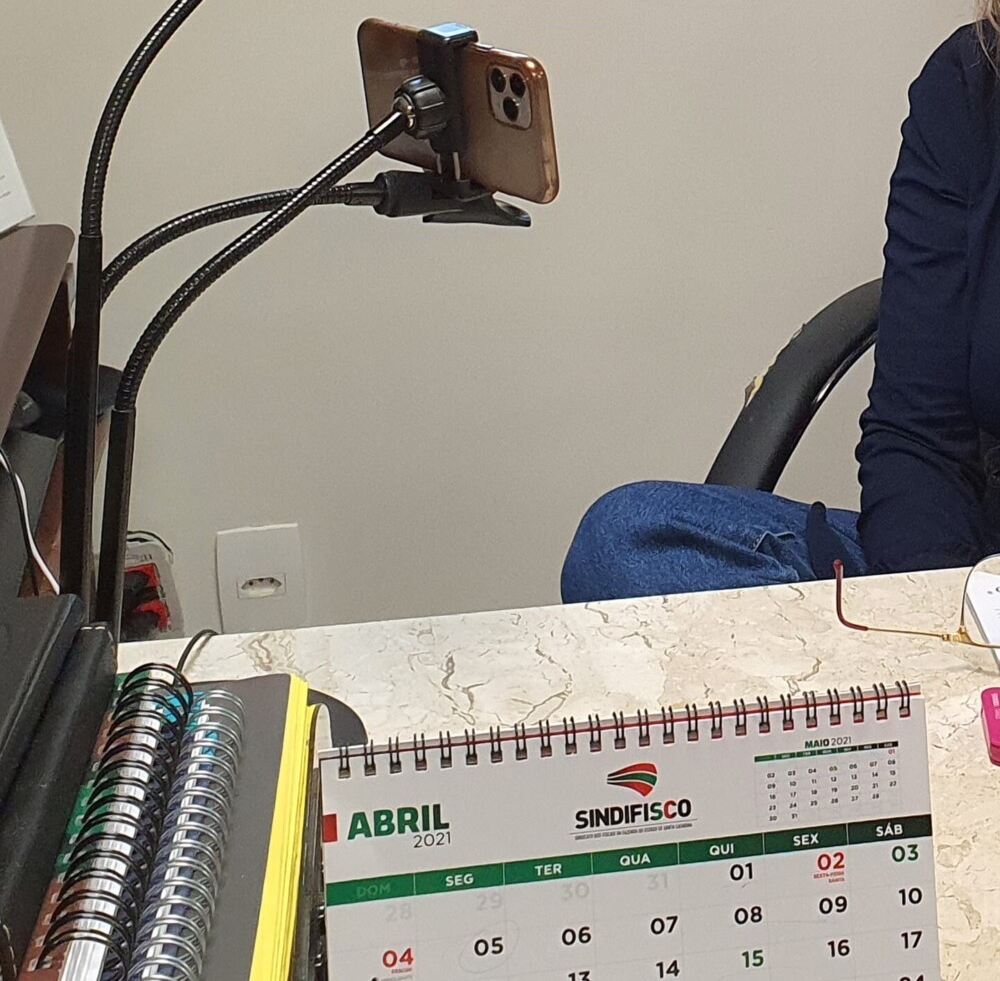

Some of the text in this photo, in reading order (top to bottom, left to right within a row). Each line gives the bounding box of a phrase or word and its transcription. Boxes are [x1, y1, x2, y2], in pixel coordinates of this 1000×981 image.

[805, 736, 852, 749] MAIO 2021
[347, 804, 451, 840] ABRIL
[576, 798, 692, 830] SINDIFISCO
[356, 823, 903, 898] DOM SEG TER QUA QUI SEX SÁB
[413, 832, 452, 848] 2021
[476, 894, 503, 911] 29
[561, 882, 590, 901] 30
[647, 872, 669, 890] 31
[730, 862, 754, 881] 01
[817, 852, 845, 871] 02
[892, 844, 919, 863] 03
[382, 887, 923, 969] 04 05 06 07 08 09 10
[655, 960, 680, 979] 14
[742, 949, 764, 969] 15
[827, 939, 850, 958] 16
[901, 930, 923, 949] 17
